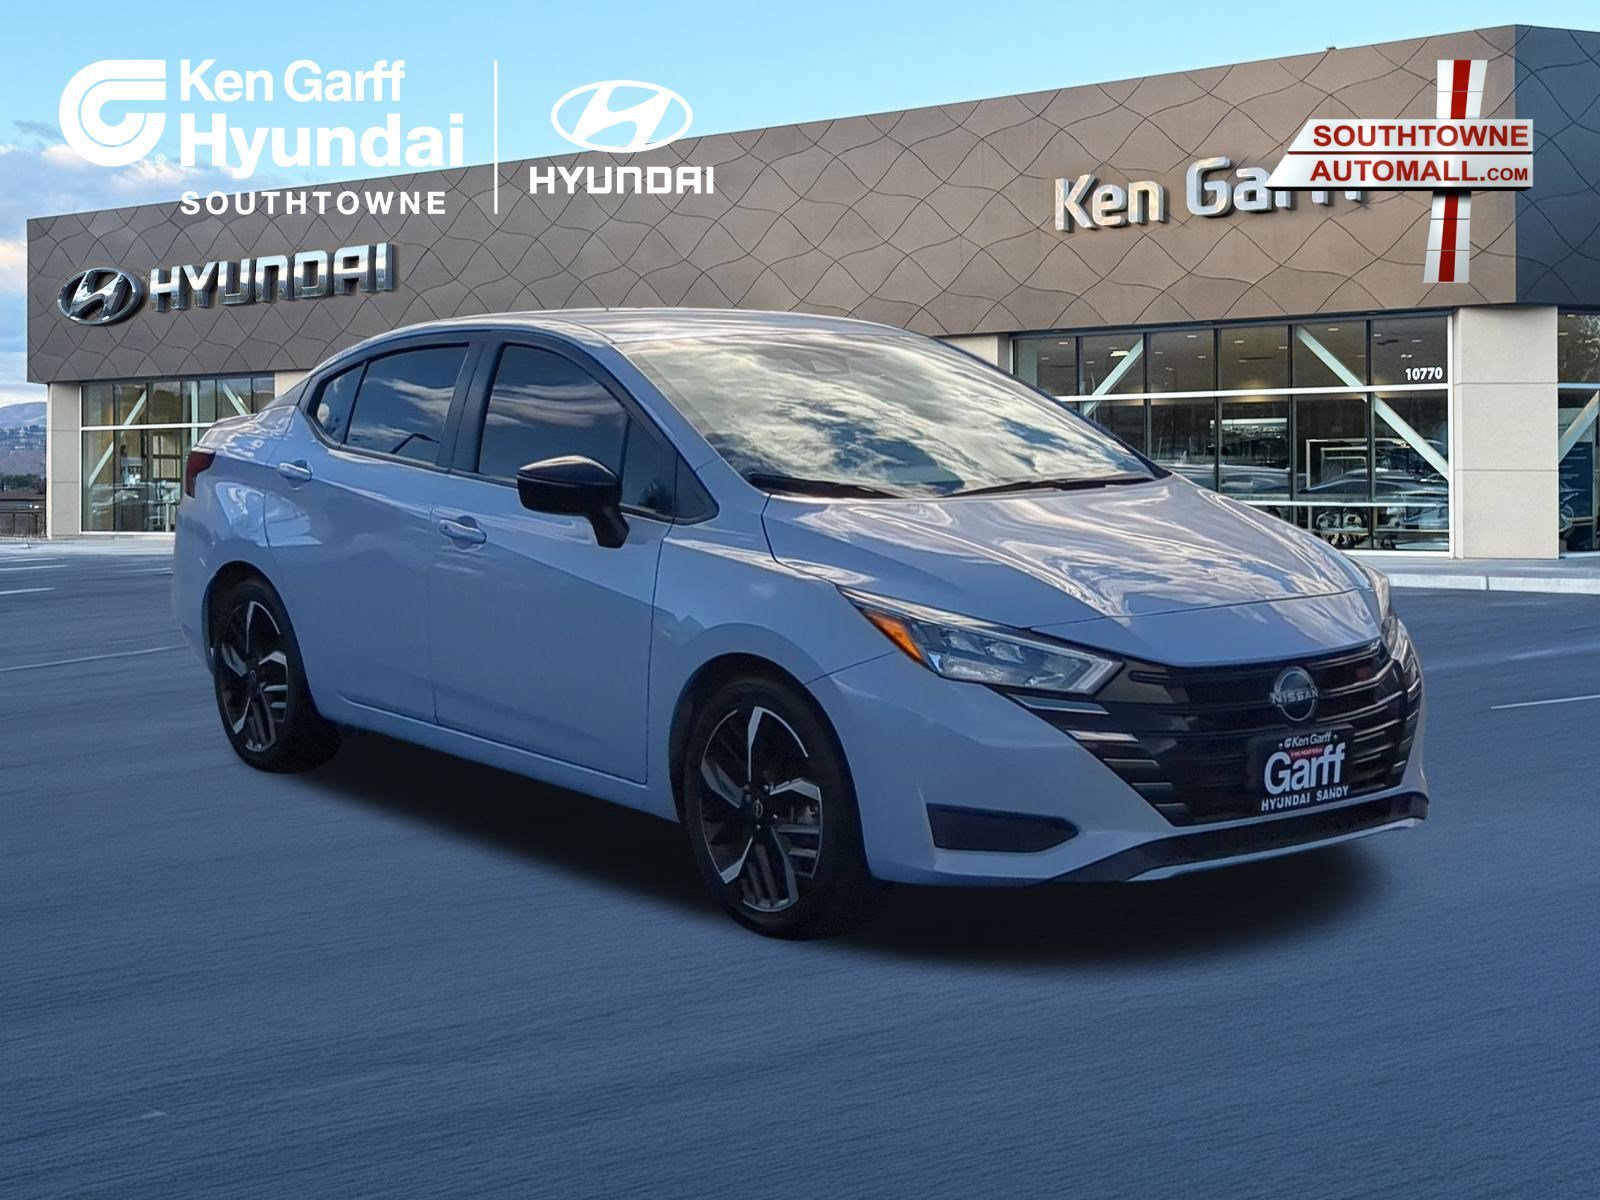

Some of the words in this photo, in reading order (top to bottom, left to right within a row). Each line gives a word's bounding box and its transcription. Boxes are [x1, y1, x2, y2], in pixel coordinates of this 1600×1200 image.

[1054, 173, 1165, 232] Ken
[149, 242, 395, 313] HYUNDAI
[1404, 365, 1444, 382] 10770
[1270, 687, 1319, 705] NISSAN
[1292, 736, 1309, 748] Ken
[1310, 731, 1332, 745] Garff
[1264, 742, 1346, 795] Garff
[1260, 792, 1311, 811] HYUNDAI
[1316, 785, 1349, 801] SANDY
